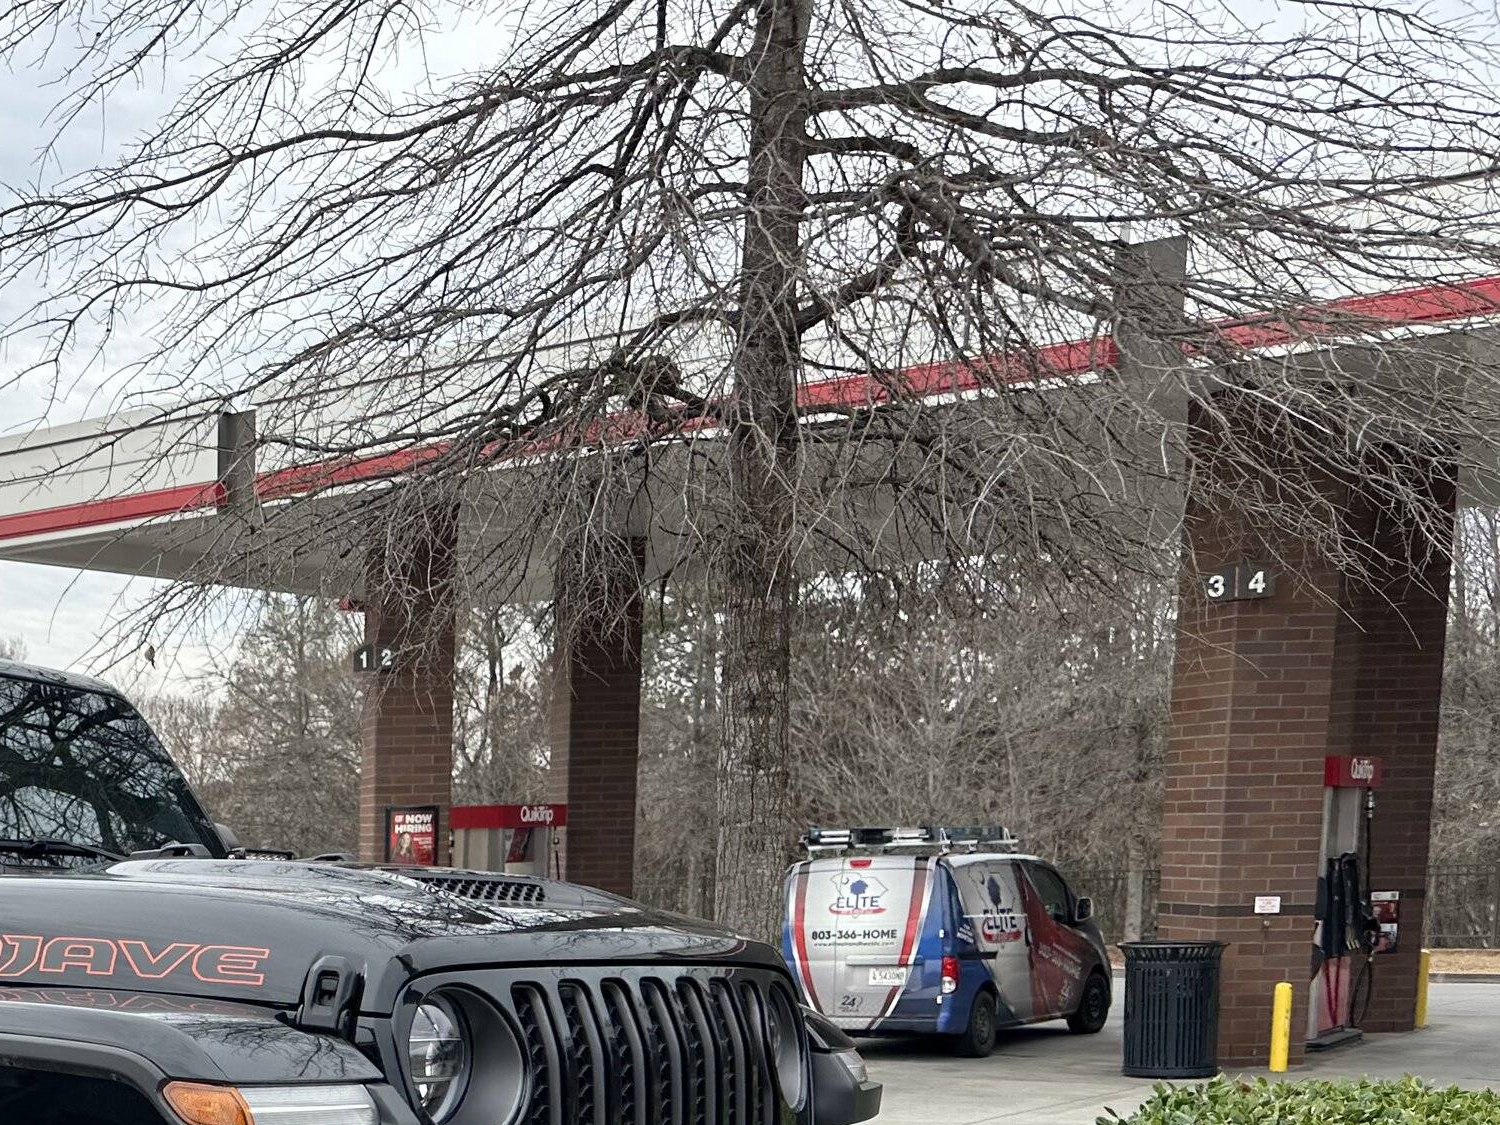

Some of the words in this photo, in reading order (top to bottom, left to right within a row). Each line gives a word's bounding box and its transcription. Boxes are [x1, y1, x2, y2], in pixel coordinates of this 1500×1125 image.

[1207, 575, 1225, 598] 3
[1248, 570, 1266, 594] 4
[360, 650, 368, 669] 1
[381, 648, 392, 666] 2
[405, 813, 433, 824] NOW
[520, 805, 554, 825] QuikTrip
[394, 823, 433, 834] HIRING
[836, 895, 881, 909] ELITE
[983, 907, 1018, 932] ELITE
[811, 929, 898, 941] 803-366-HOME
[841, 995, 857, 1007] 24
